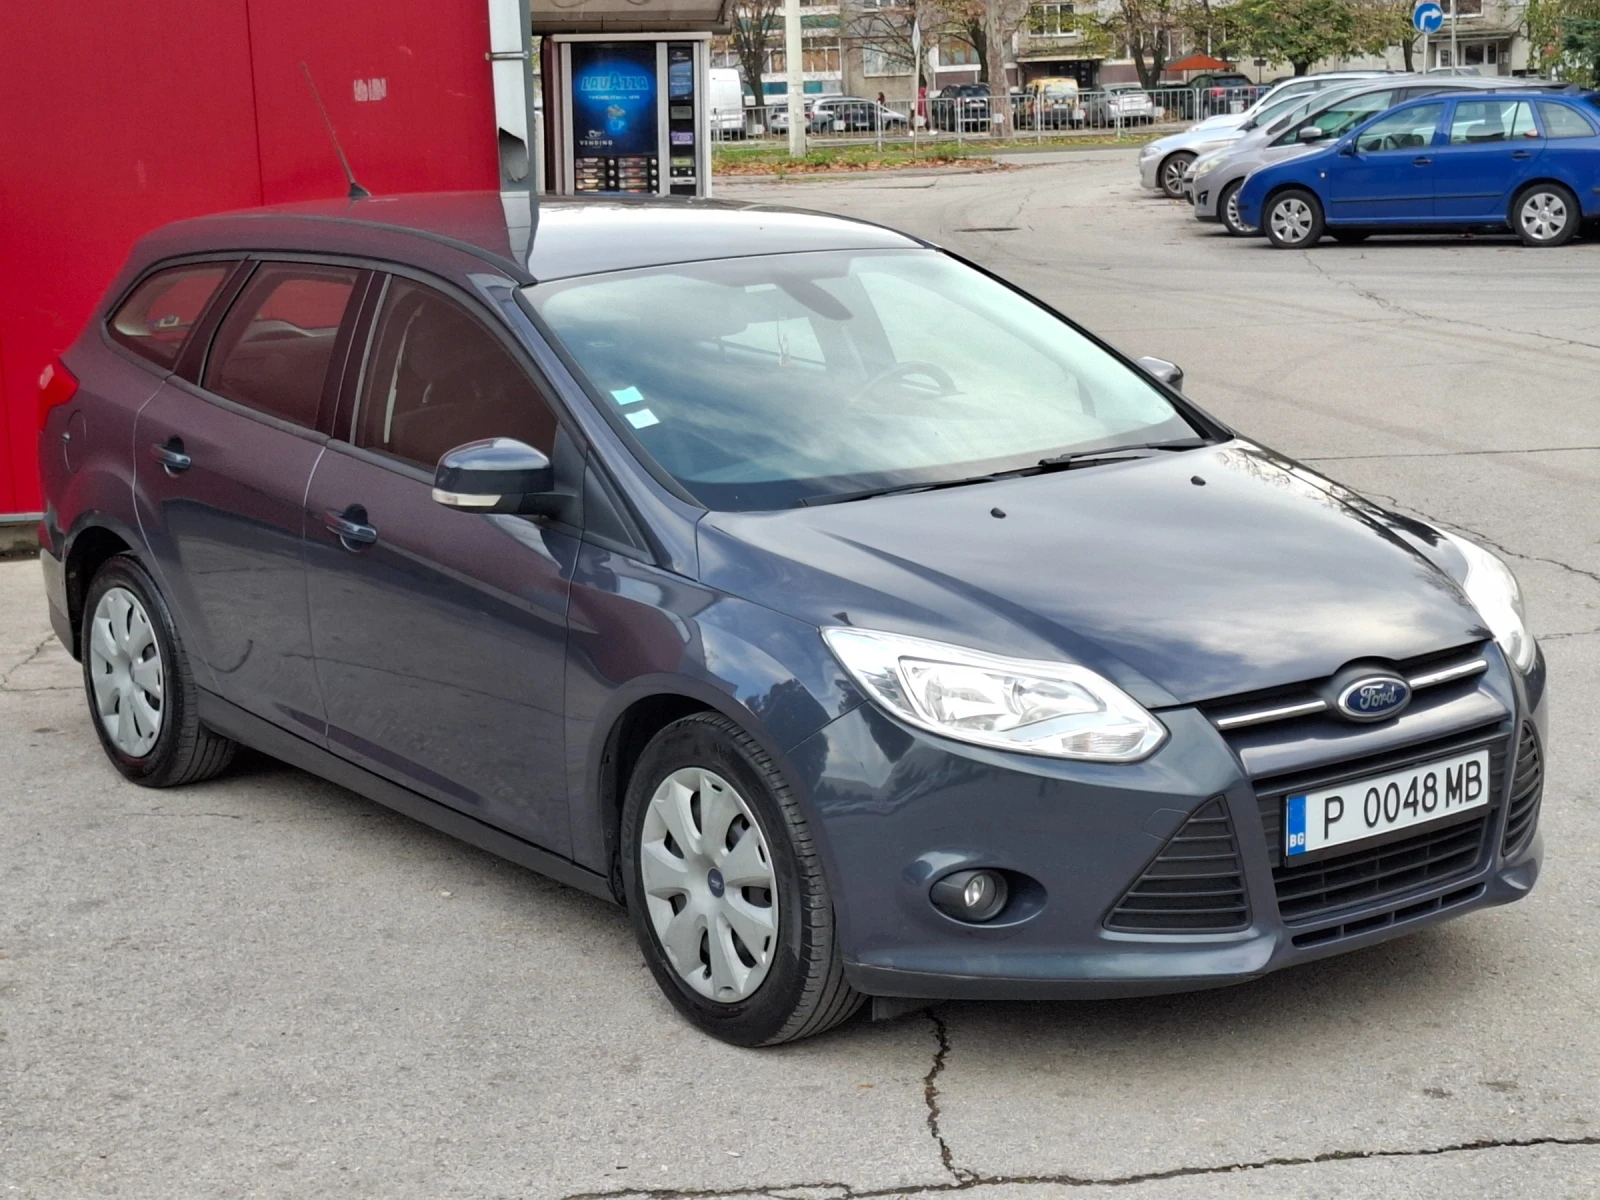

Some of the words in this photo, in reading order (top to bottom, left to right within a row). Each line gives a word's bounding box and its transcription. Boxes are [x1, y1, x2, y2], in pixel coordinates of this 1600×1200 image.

[581, 71, 649, 91] LAVAZZA
[1359, 684, 1397, 709] Ford
[1323, 795, 1344, 841] P
[1363, 771, 1438, 829] 0048
[1445, 759, 1482, 809] MB
[1289, 833, 1305, 847] BG
